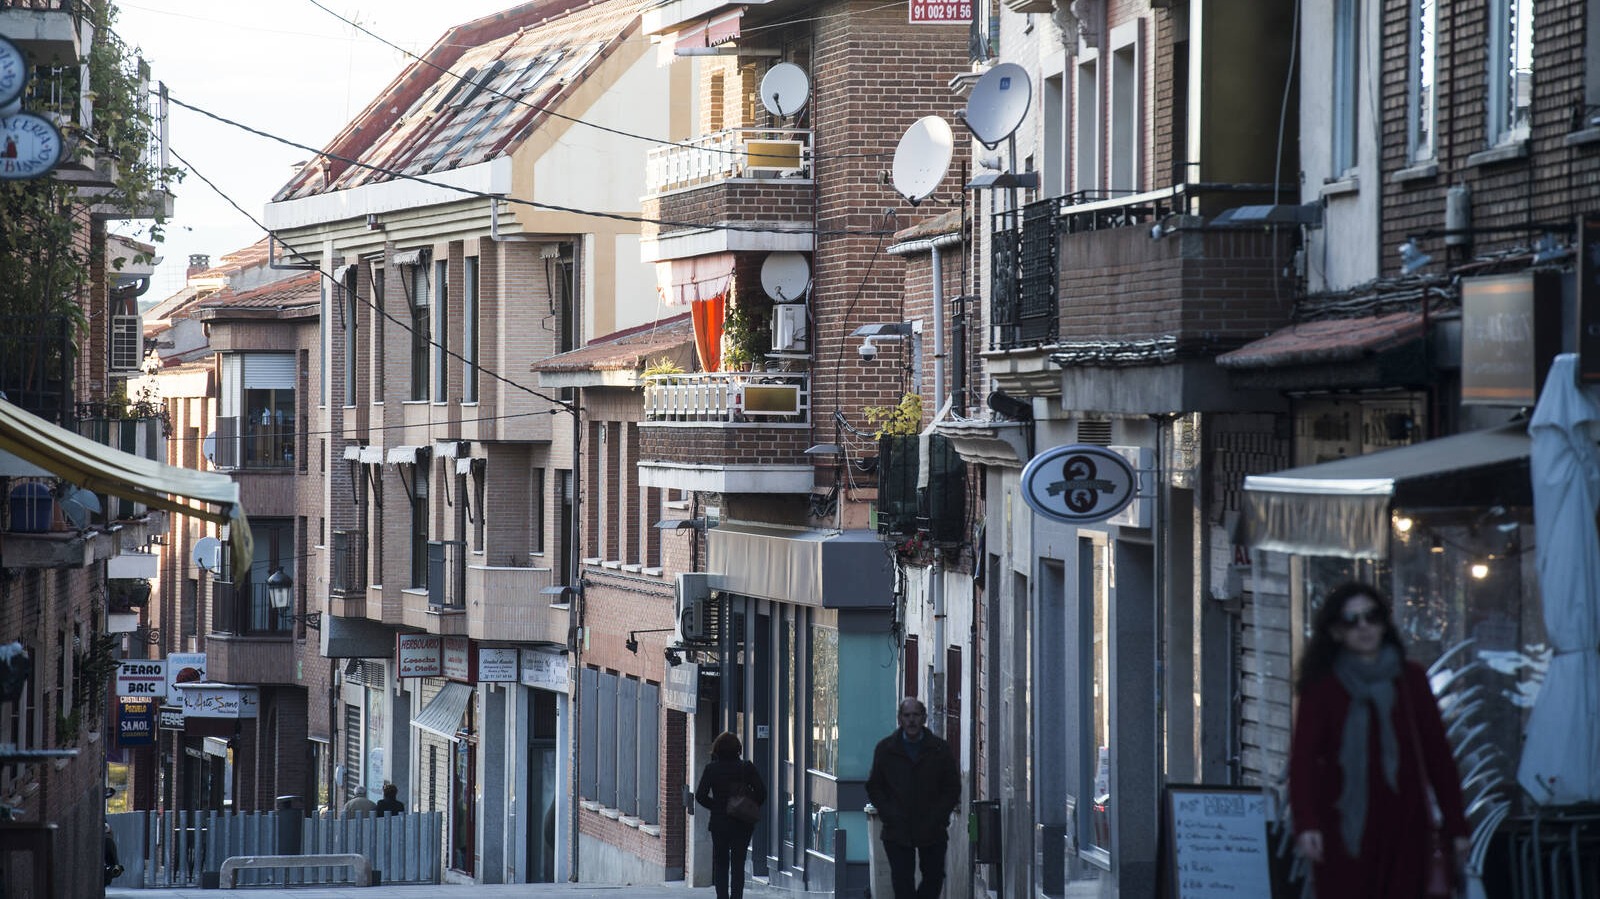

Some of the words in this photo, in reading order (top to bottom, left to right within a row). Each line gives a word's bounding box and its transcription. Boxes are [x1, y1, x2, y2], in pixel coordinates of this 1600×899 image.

[914, 5, 925, 19] 91
[927, 5, 945, 18] 002
[946, 5, 957, 18] 91
[959, 5, 972, 18] 56
[401, 638, 439, 650] HERBOLARIO
[403, 656, 436, 664] Cosecha
[122, 664, 162, 675] FERRO
[128, 682, 156, 693] BRIC
[121, 720, 150, 731] SAMOL
